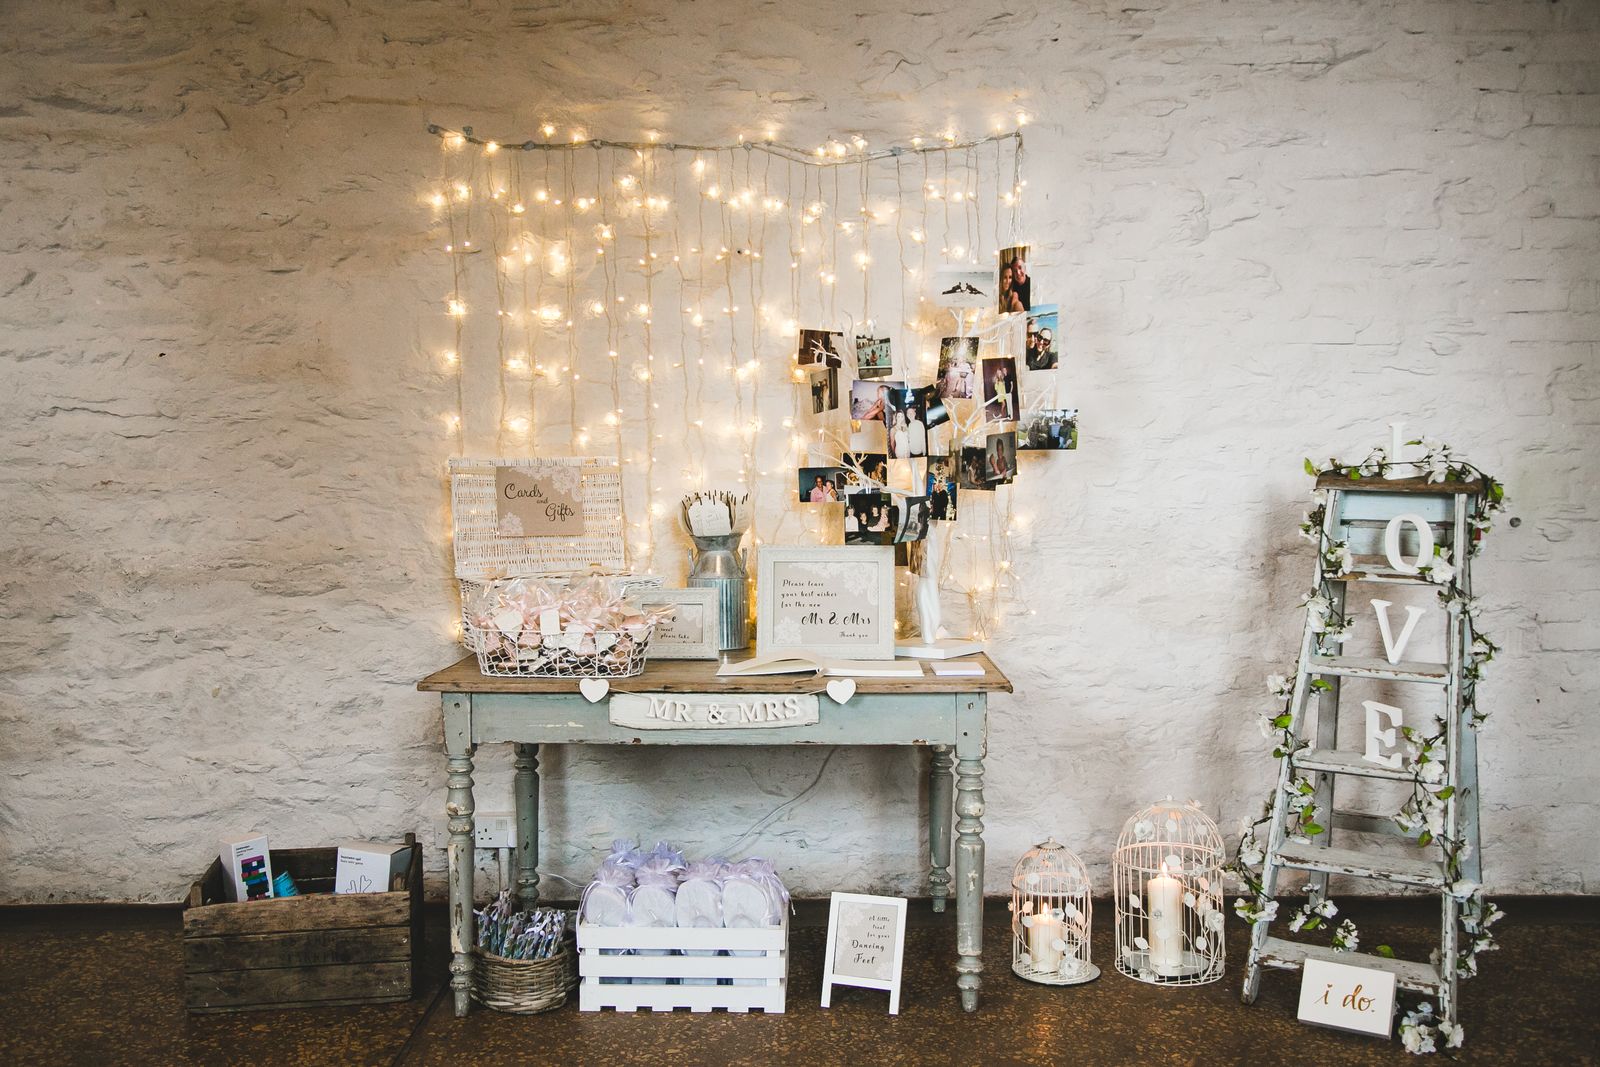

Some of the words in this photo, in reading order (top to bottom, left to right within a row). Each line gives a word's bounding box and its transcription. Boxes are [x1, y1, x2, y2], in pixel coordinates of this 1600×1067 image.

[504, 483, 544, 499] Cards
[536, 497, 549, 505] and
[545, 503, 575, 522] Gifts
[782, 579, 805, 587] Please
[780, 601, 792, 609] for
[801, 612, 823, 625] Mr
[828, 611, 839, 625] &
[843, 612, 871, 625] Mrs
[647, 696, 693, 722] MR
[708, 703, 727, 723] &
[739, 696, 799, 722] MRS
[852, 939, 885, 952] Dancing
[853, 953, 875, 963] Feet
[1314, 983, 1333, 1005] i
